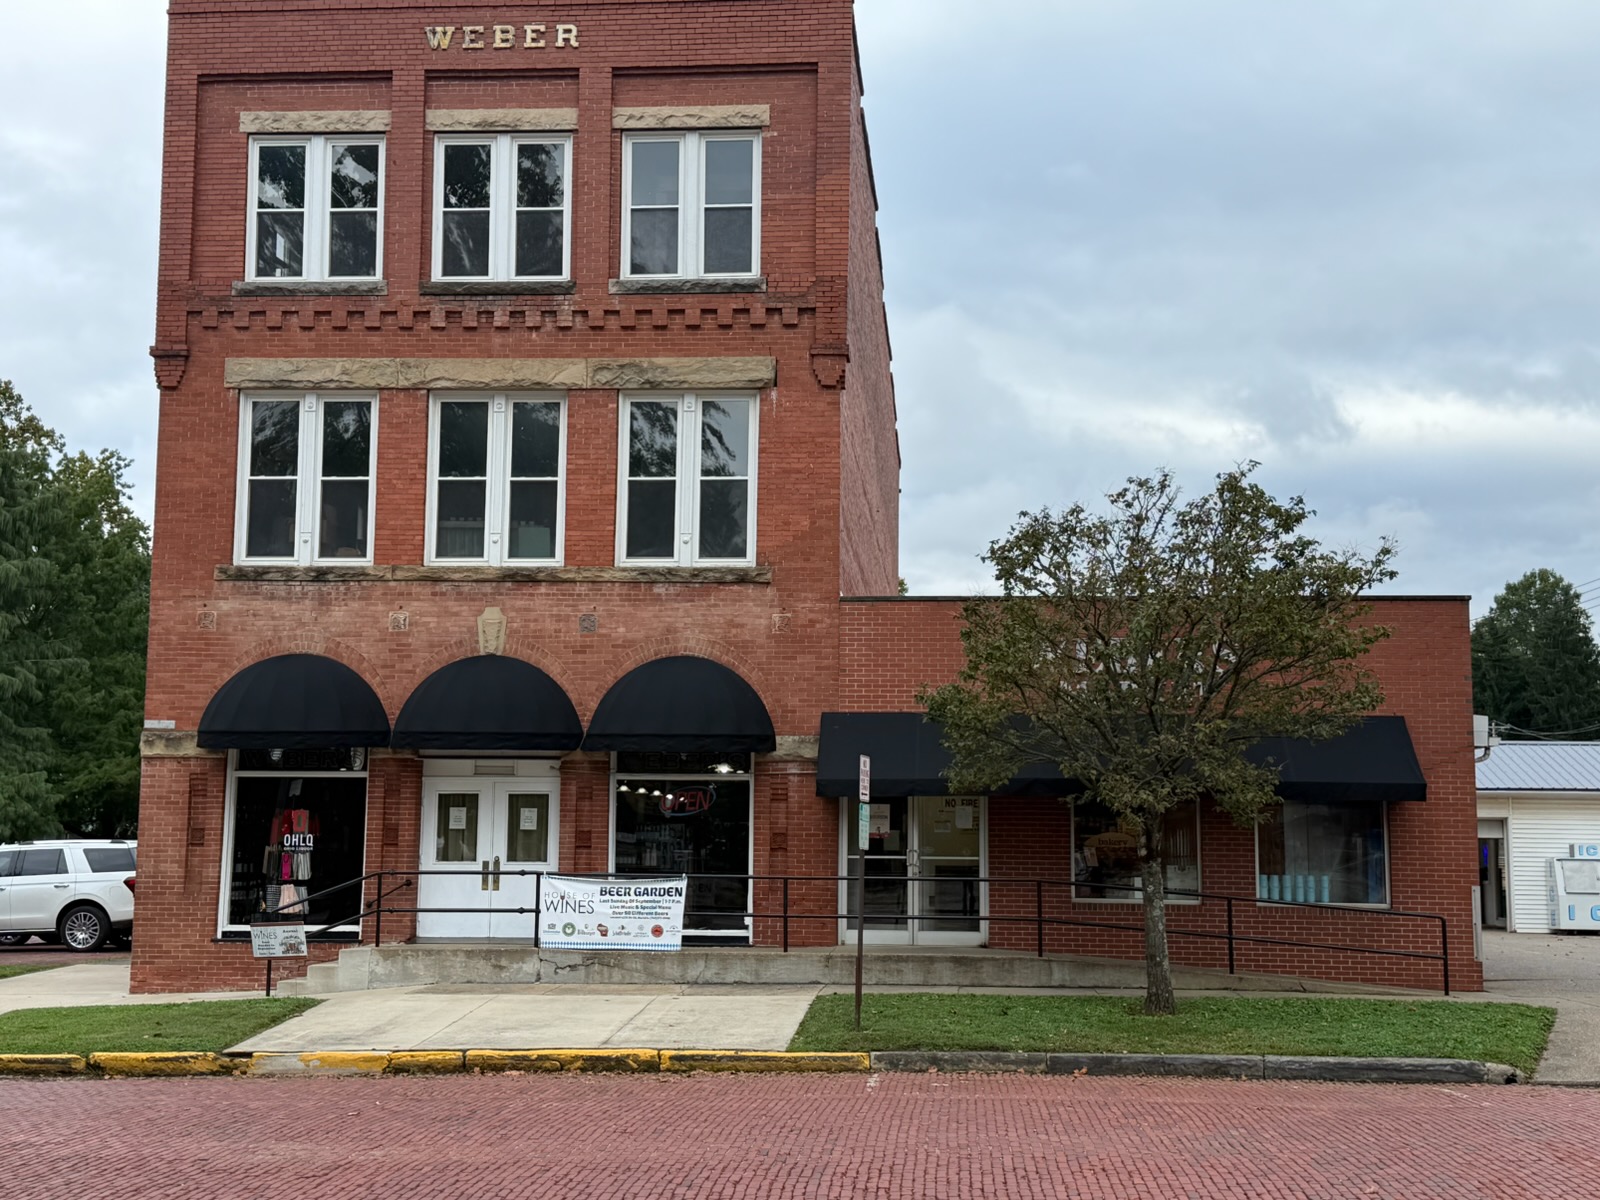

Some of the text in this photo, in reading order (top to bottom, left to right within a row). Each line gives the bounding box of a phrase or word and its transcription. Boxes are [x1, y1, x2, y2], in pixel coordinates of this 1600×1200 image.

[424, 24, 580, 50] WEBER
[244, 749, 363, 769] WBER'S
[661, 791, 710, 811] OPEN
[945, 798, 956, 808] NO
[283, 833, 314, 847] OHLQ
[1098, 838, 1128, 846] bakery
[544, 890, 577, 899] HOUSE
[599, 886, 683, 897] BEER GARDEN
[544, 899, 595, 914] WINES
[253, 930, 278, 940] WINES
